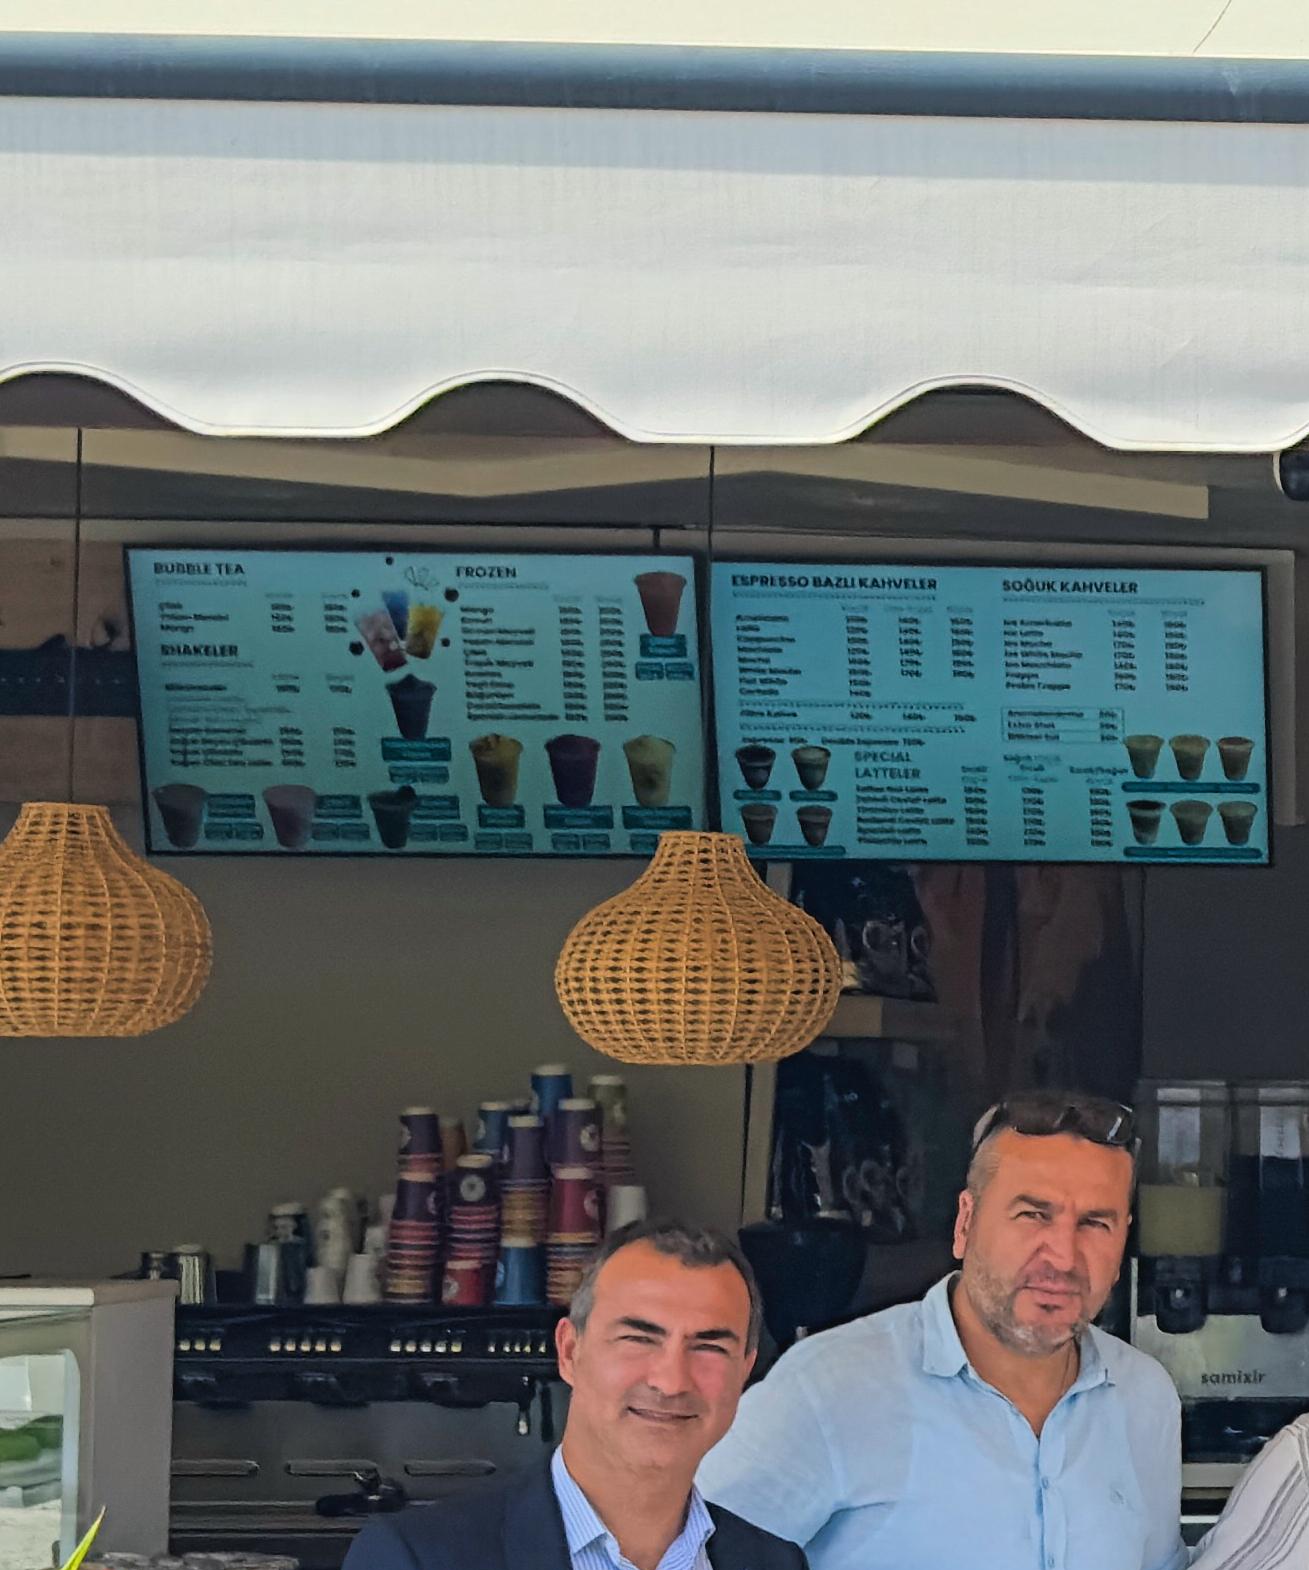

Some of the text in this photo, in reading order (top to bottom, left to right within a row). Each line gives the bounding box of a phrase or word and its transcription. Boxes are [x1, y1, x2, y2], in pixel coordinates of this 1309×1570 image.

[216, 563, 245, 575] TEA
[456, 566, 516, 578] FROZEN
[731, 574, 808, 588] ESPRESSO
[858, 577, 938, 590] KAHVELER
[1002, 577, 1138, 593] SOĞUK KAHVELER
